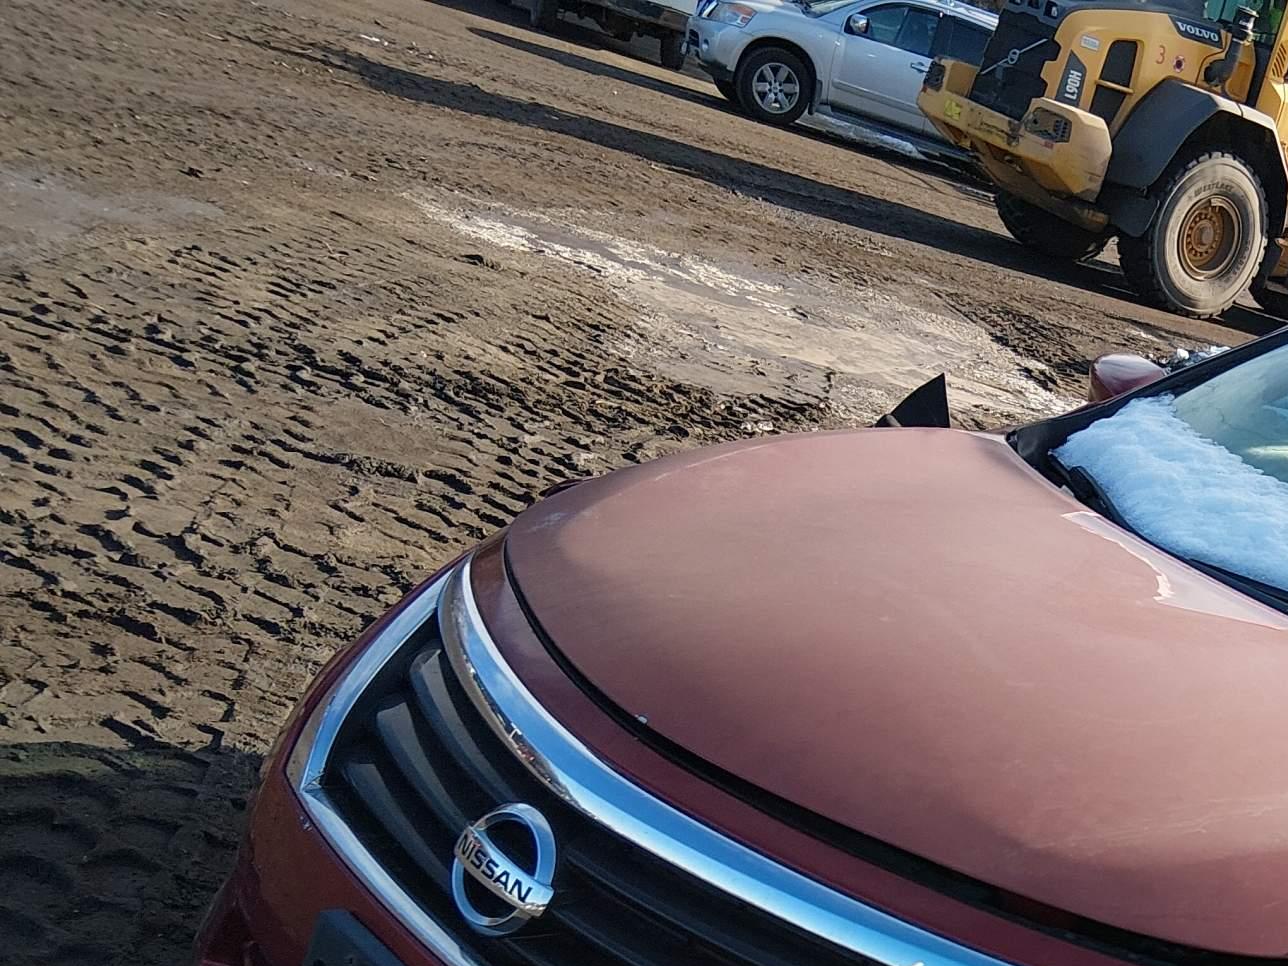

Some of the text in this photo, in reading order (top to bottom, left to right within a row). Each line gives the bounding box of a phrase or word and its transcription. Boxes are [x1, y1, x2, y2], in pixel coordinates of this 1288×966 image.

[1176, 21, 1220, 43] VOLVO
[1064, 69, 1083, 100] L90H
[458, 834, 533, 903] NISSAN
